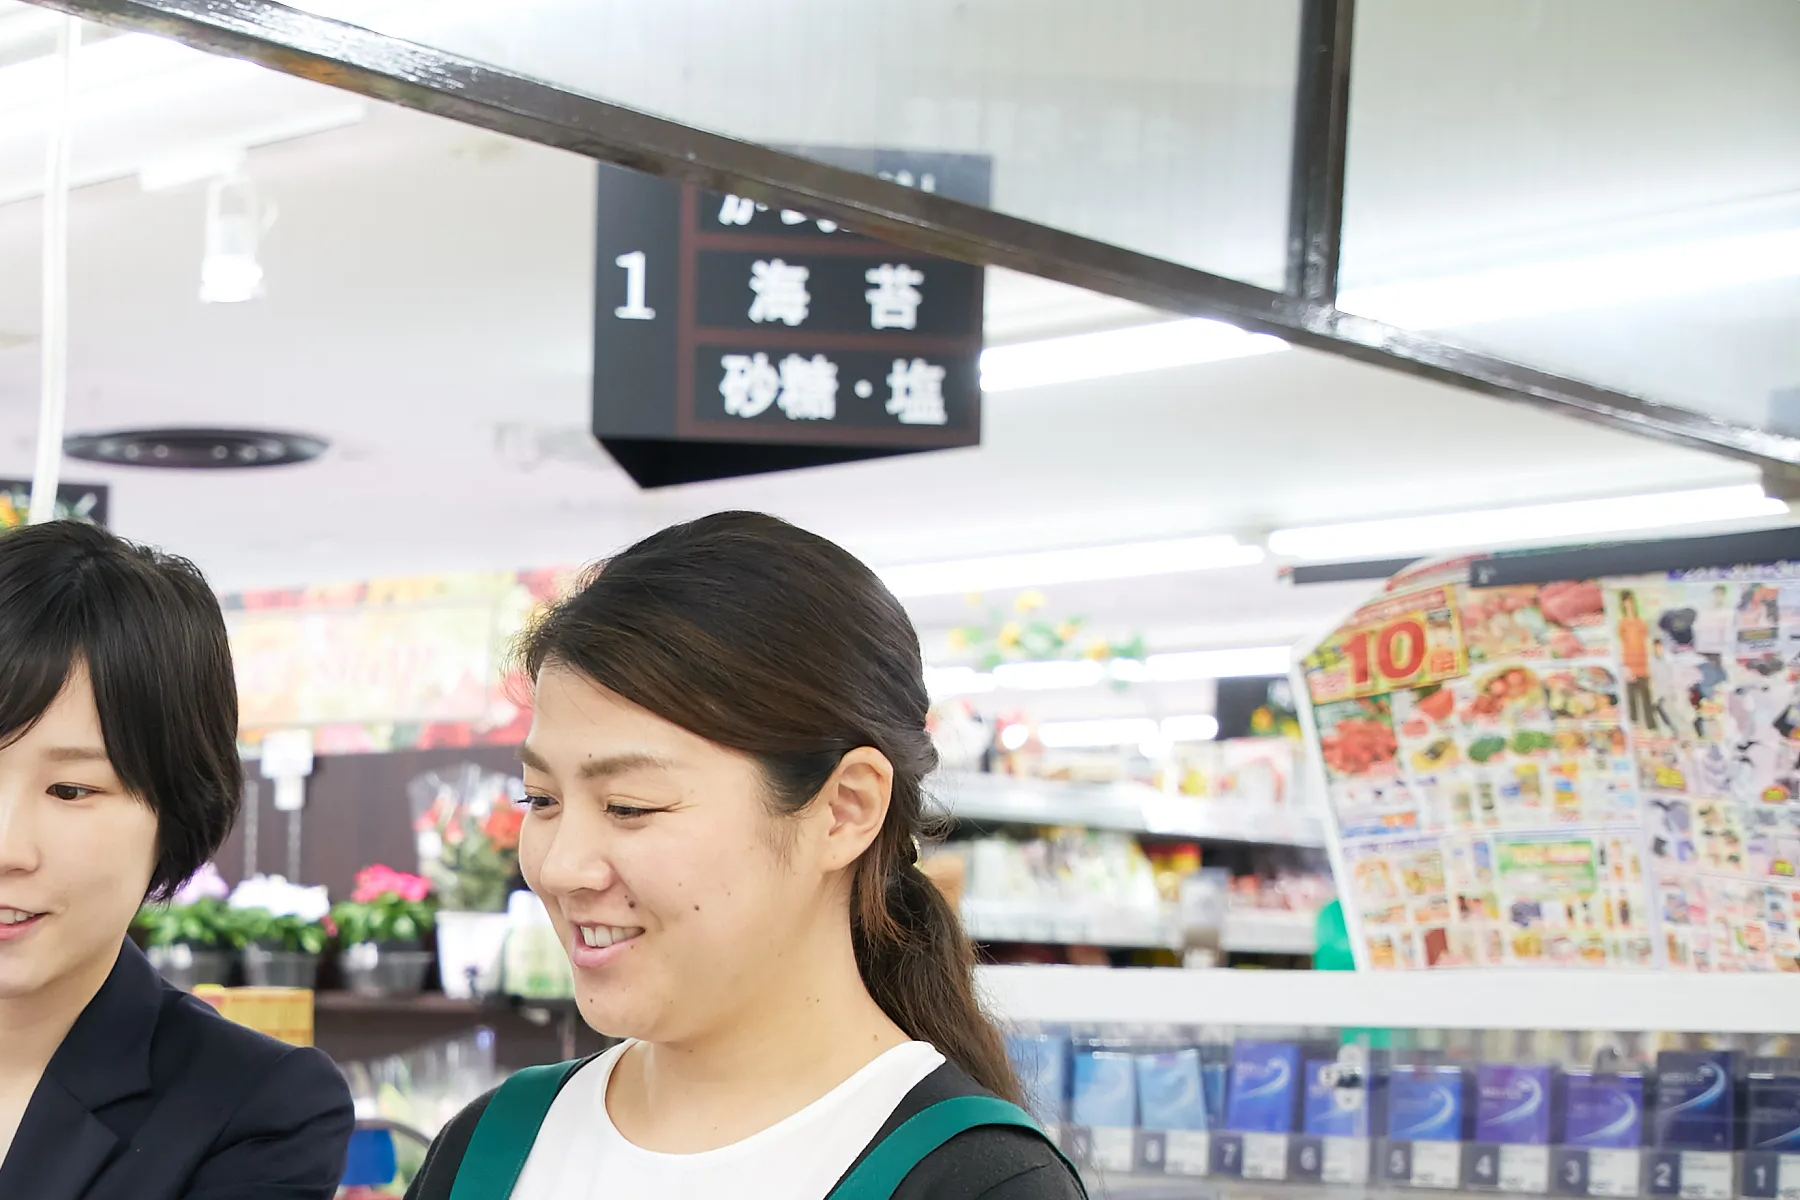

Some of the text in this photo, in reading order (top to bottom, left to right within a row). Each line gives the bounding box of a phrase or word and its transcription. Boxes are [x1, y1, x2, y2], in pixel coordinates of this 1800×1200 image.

[614, 250, 656, 321] 1
[748, 258, 924, 331] 海苔
[719, 351, 948, 426] 砂糖・塩
[1342, 619, 1426, 684] 10
[1223, 1143, 1236, 1167] 7
[1475, 1155, 1492, 1178] 4
[1565, 1159, 1581, 1185] 3
[1655, 1163, 1671, 1188] 2
[1755, 1165, 1766, 1189] 1
